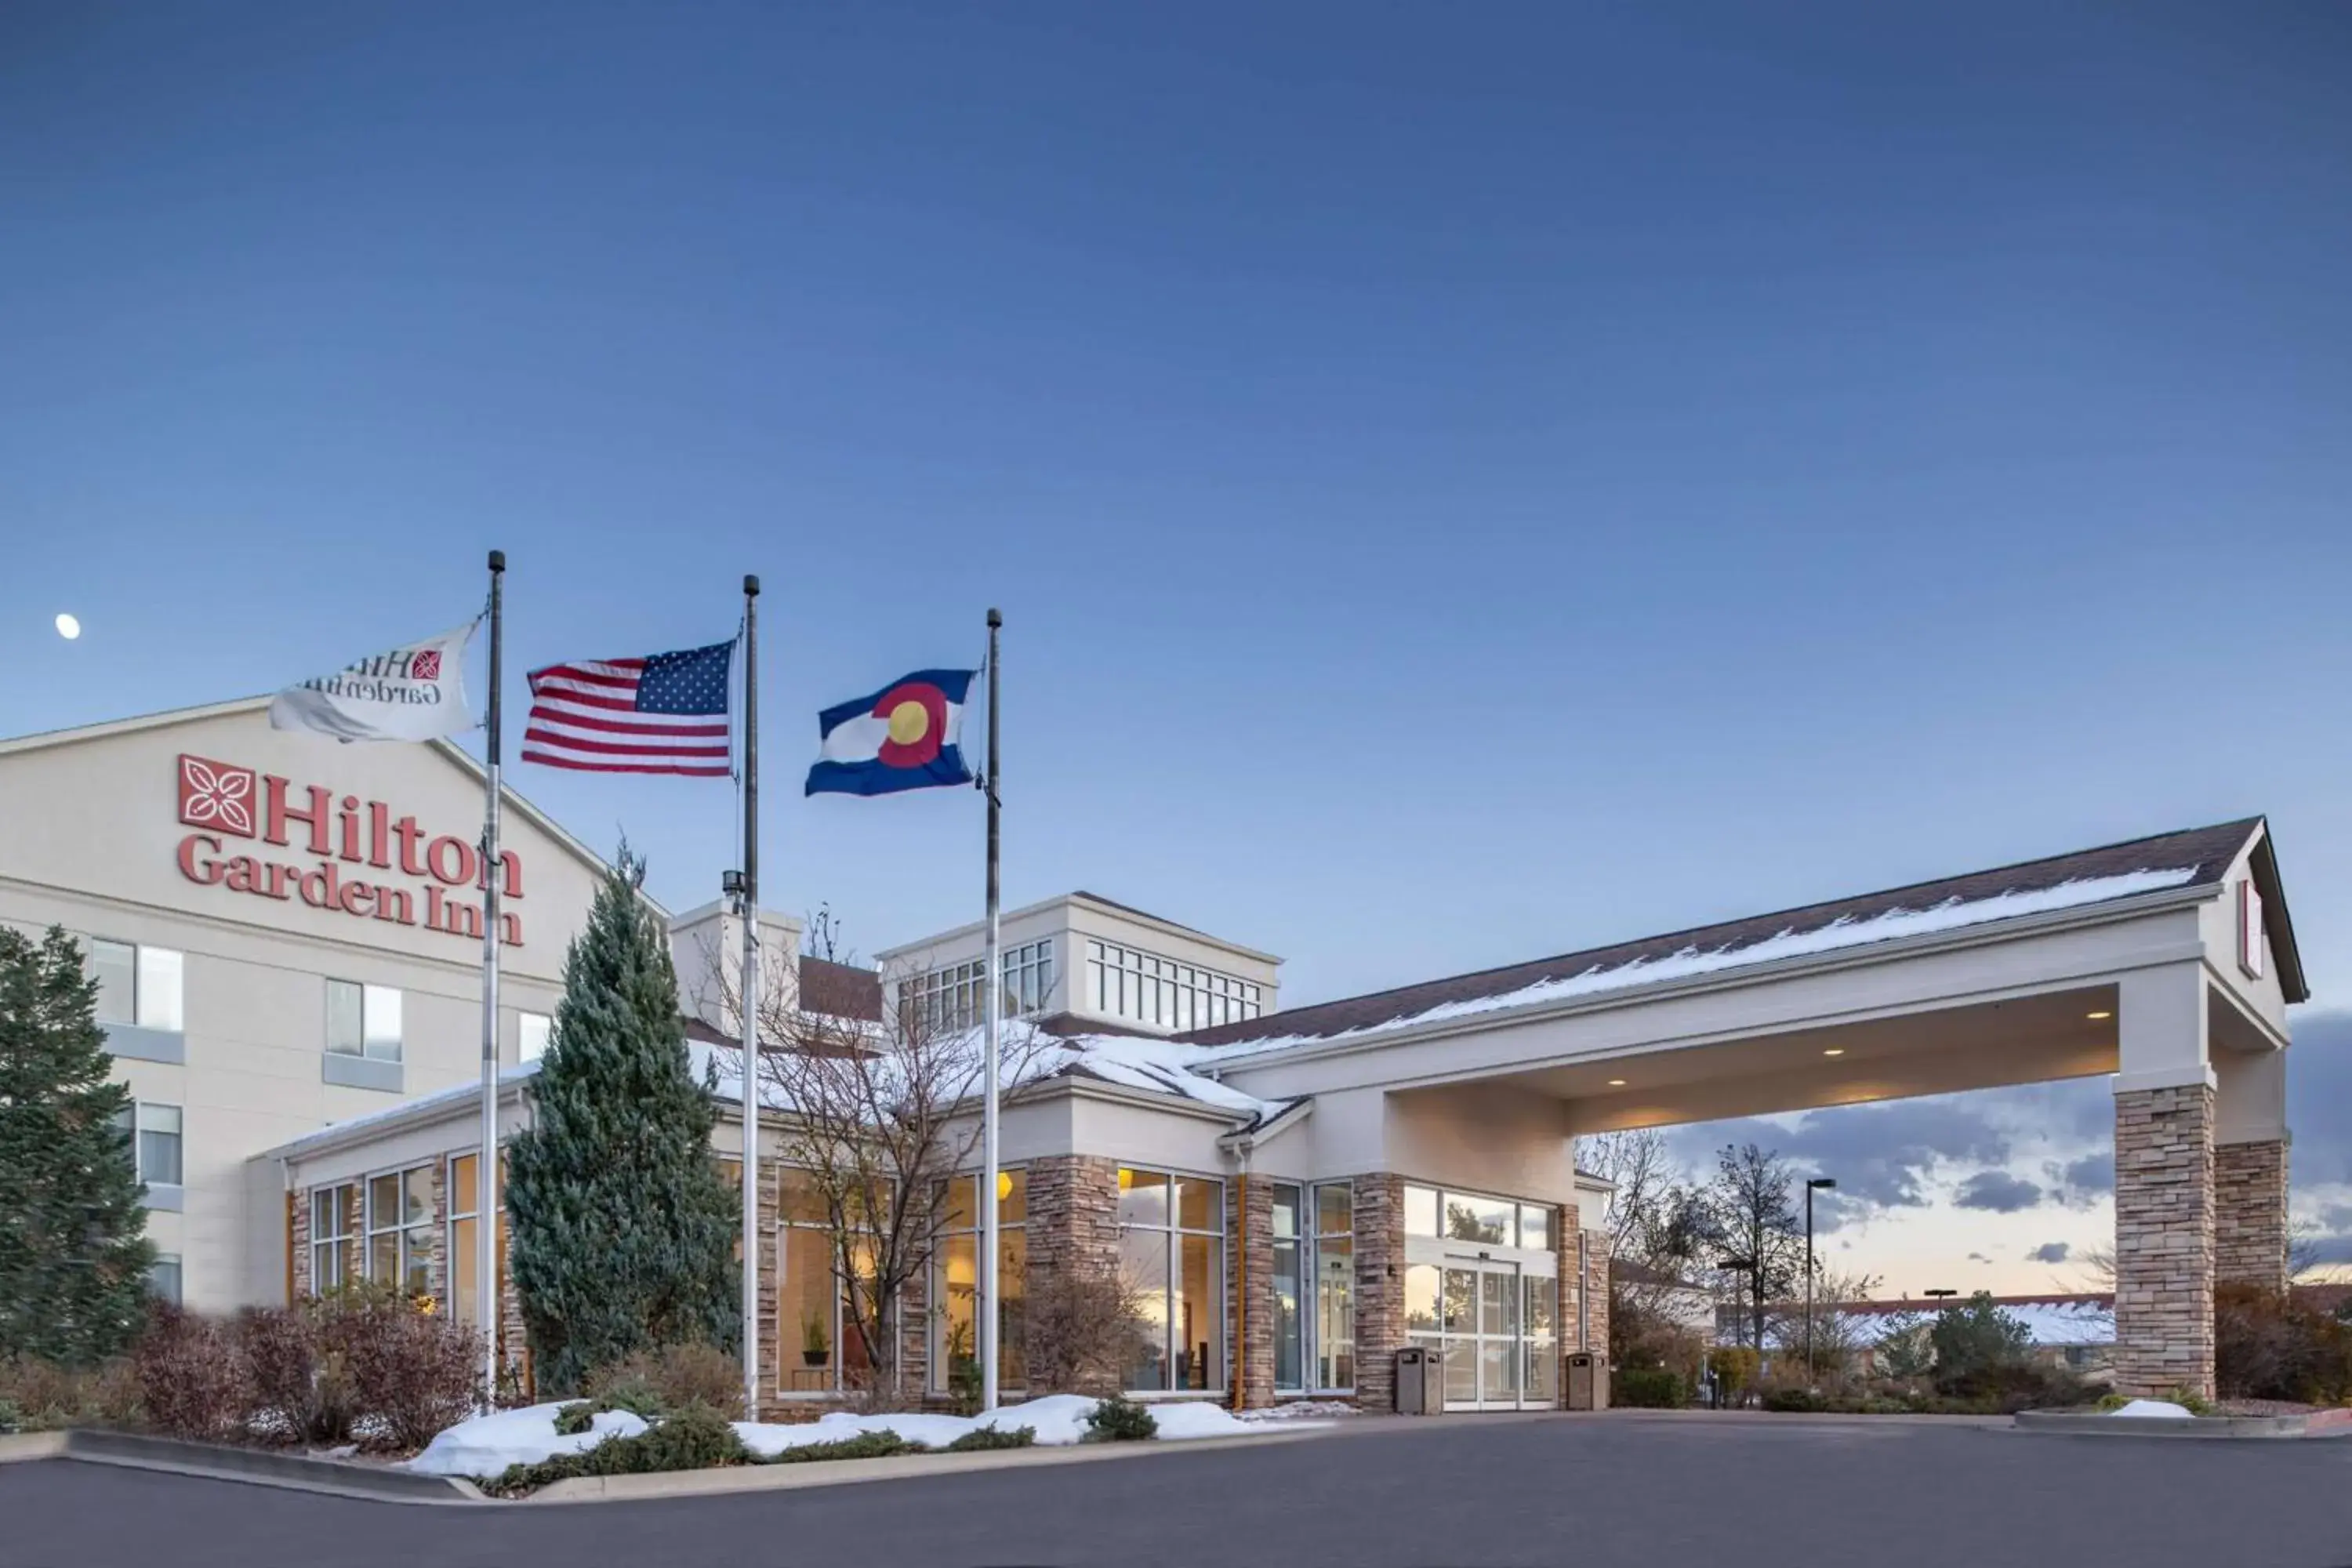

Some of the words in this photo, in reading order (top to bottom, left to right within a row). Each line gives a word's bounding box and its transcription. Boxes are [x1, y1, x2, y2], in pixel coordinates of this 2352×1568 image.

[177, 833, 416, 925] Garden
[424, 885, 524, 946] Inn
[263, 773, 524, 898] Hilton
